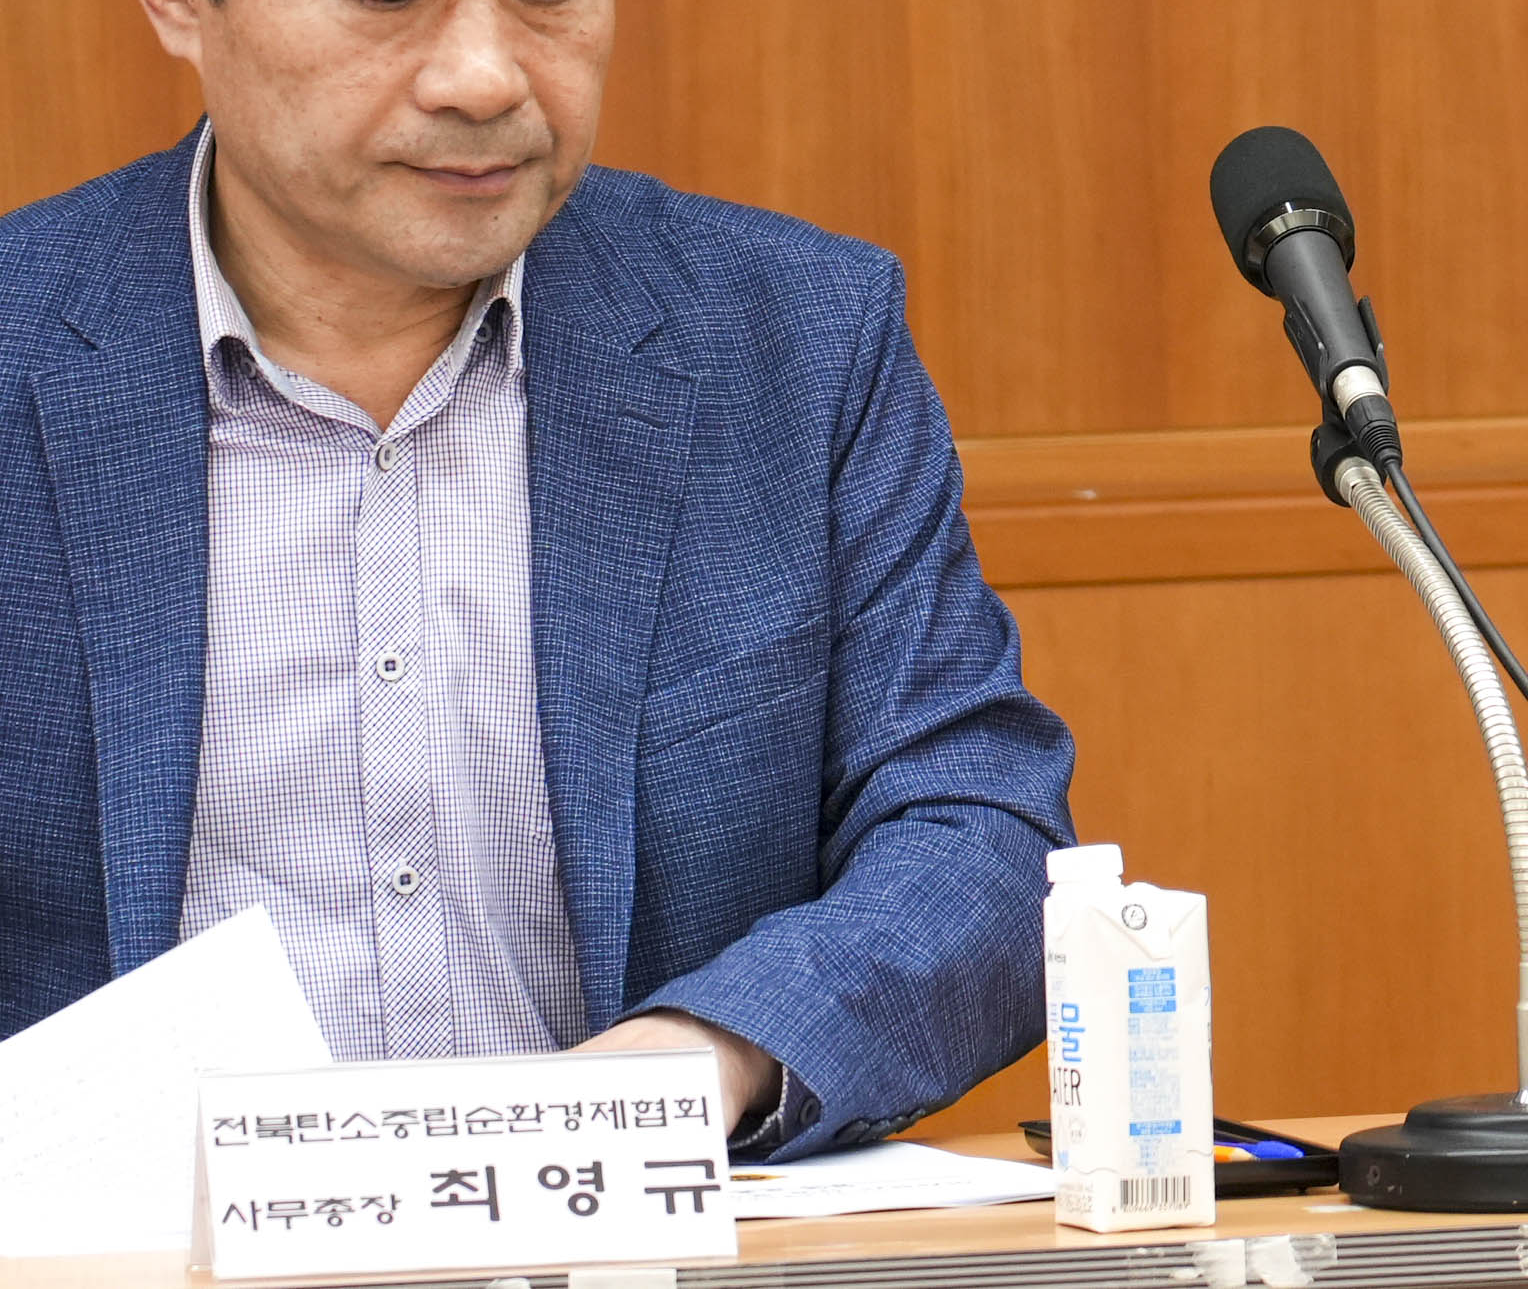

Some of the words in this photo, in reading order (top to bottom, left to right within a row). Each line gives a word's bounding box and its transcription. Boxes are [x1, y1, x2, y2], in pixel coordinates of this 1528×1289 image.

[1051, 1068, 1082, 1108] ATER
[214, 1096, 710, 1147] 전북탄소중립순환경제협회
[222, 1194, 402, 1231] 사무총장
